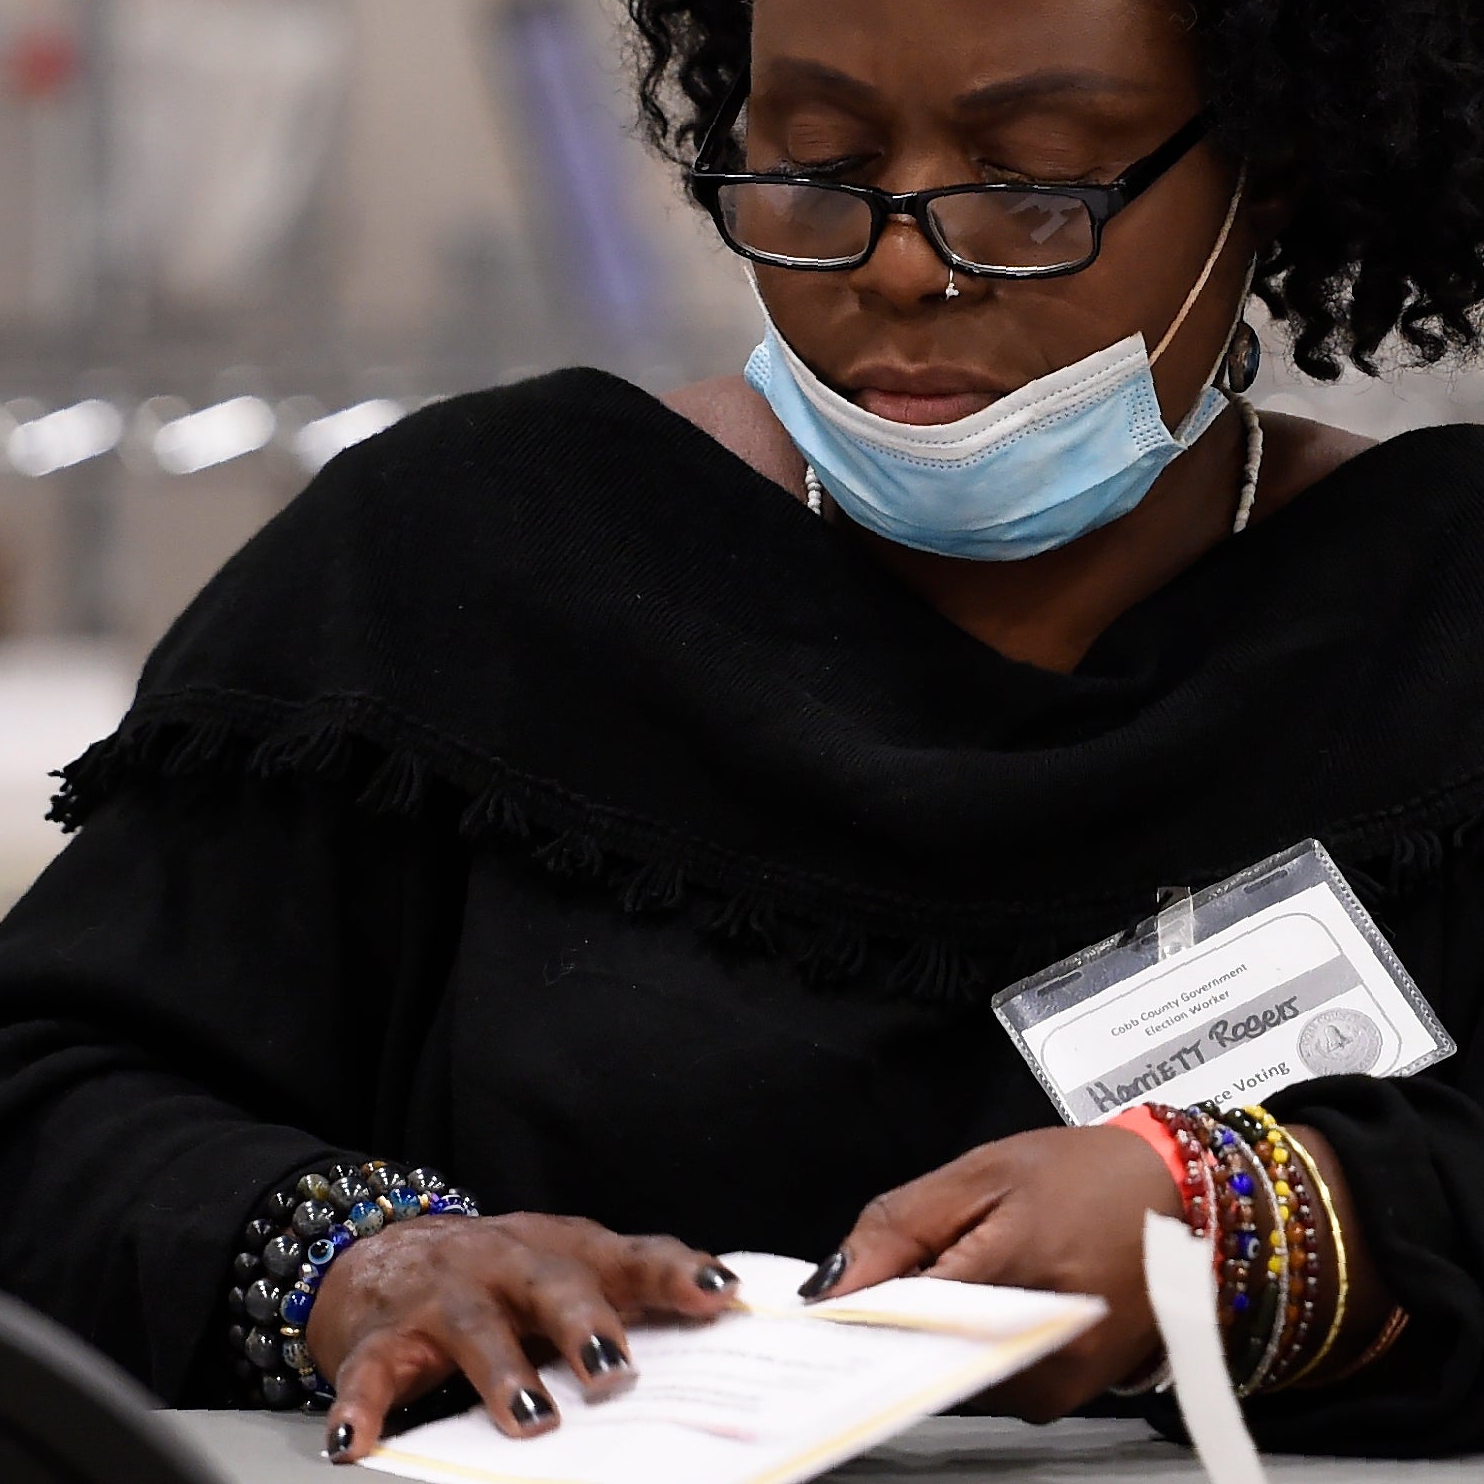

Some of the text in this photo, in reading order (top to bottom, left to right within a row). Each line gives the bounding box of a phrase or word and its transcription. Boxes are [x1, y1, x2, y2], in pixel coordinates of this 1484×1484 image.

[1111, 964, 1248, 1037] Cobb County Government
[1145, 990, 1230, 1037] Election Worker
[1232, 1061, 1291, 1092] Voting
